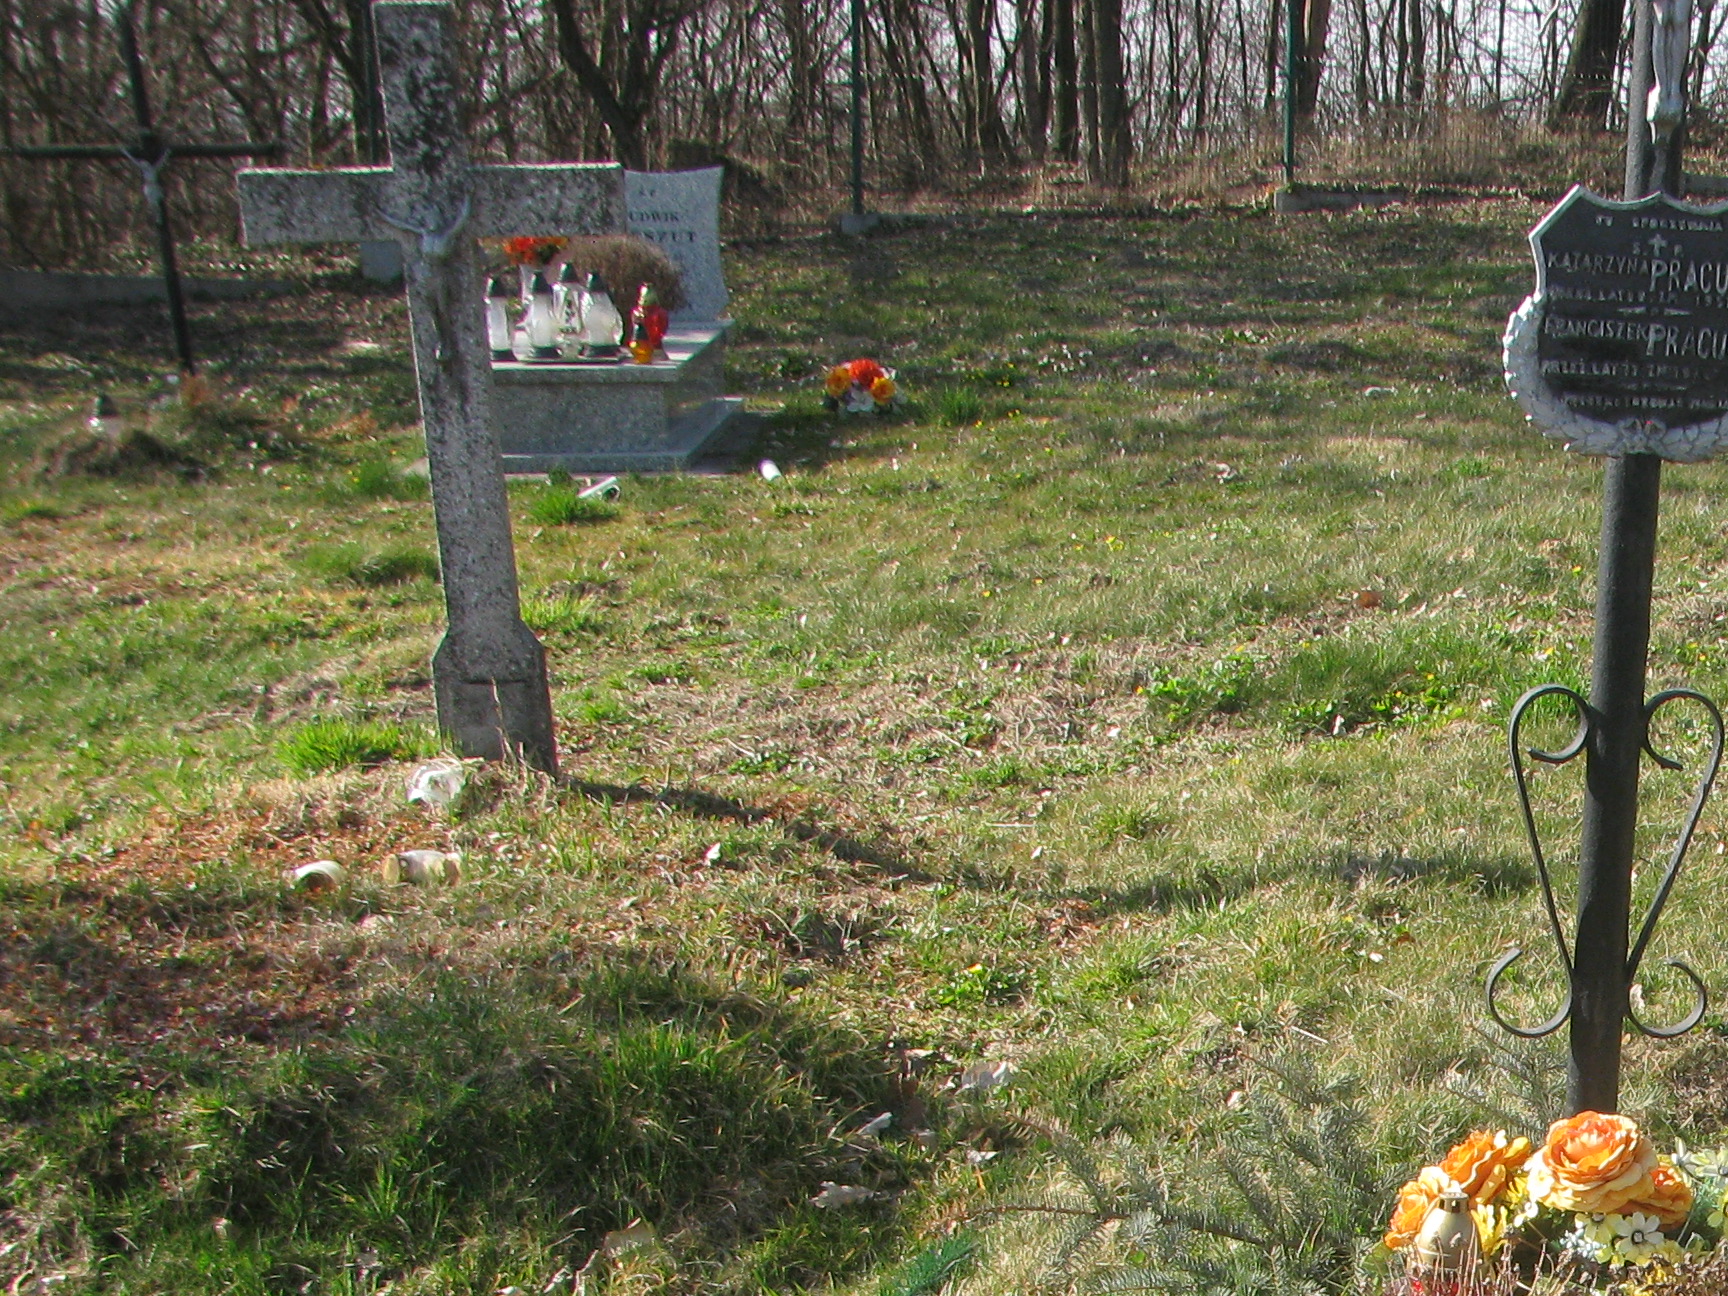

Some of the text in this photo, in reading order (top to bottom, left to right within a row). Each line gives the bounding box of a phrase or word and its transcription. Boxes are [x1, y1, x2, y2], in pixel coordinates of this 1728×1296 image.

[628, 211, 680, 222] UDWIK
[1547, 251, 1650, 276] KATARZYNA
[1543, 314, 1649, 343] FRANCISZEK
